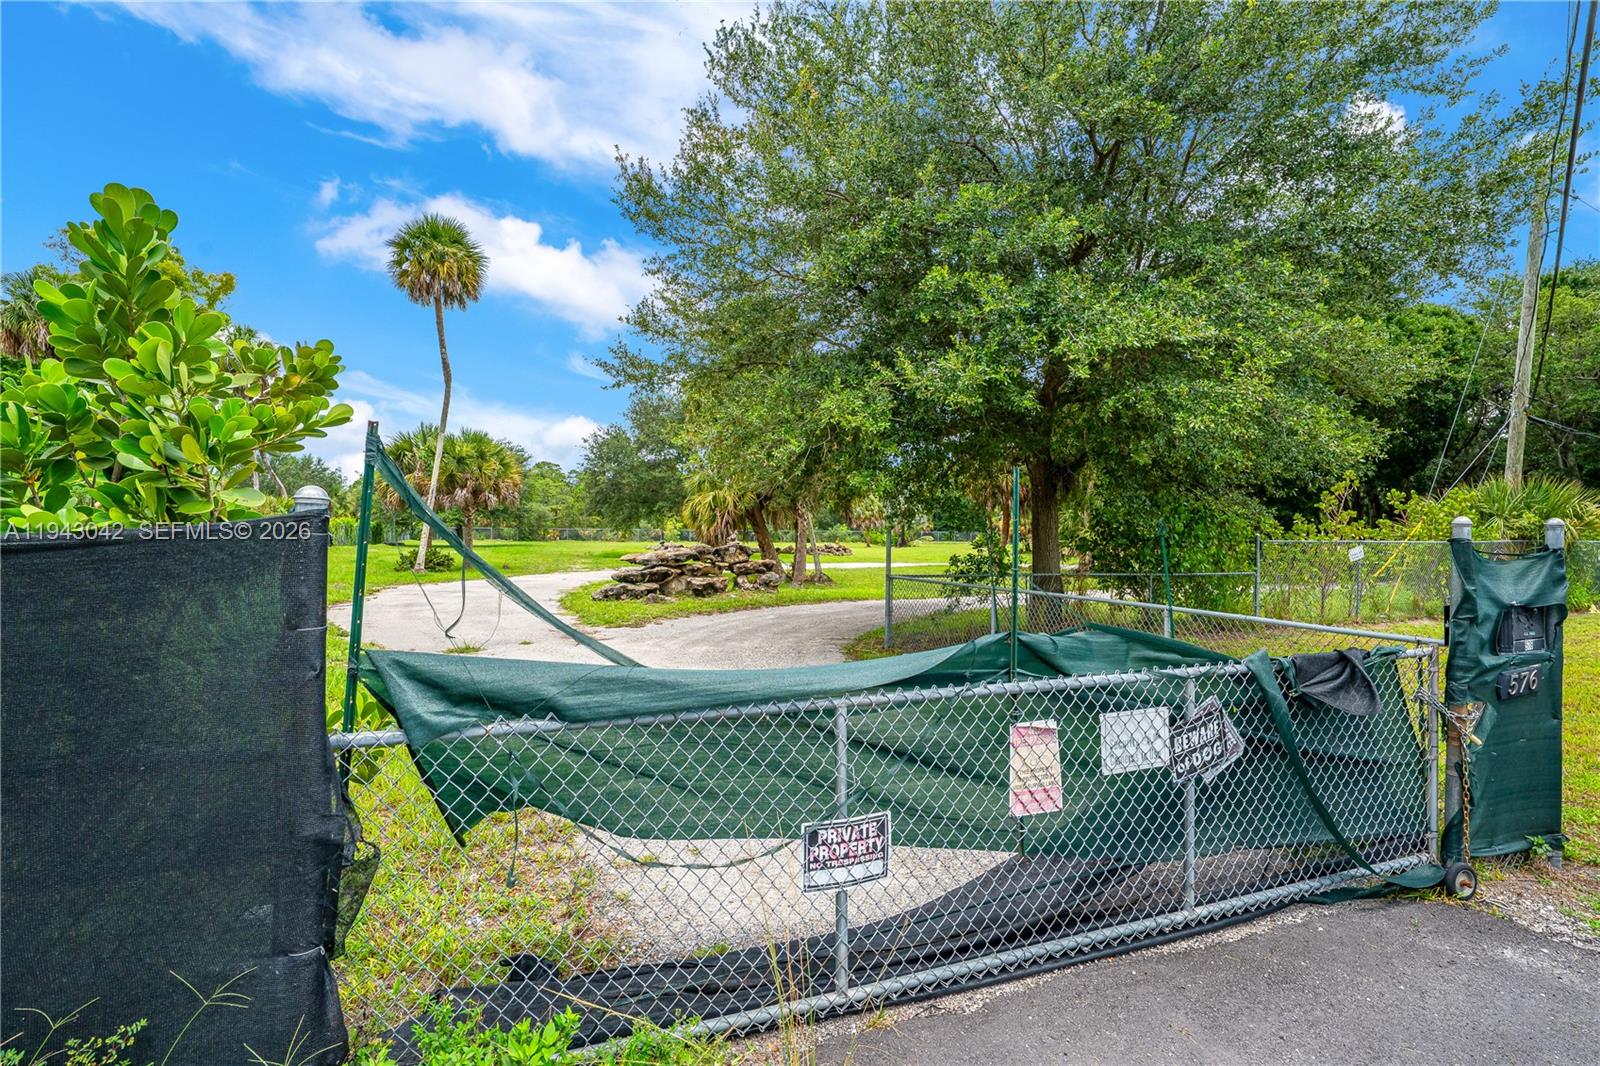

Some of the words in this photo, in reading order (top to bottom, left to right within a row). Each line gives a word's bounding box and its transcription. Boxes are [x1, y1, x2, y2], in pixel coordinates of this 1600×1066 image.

[1508, 670, 1538, 695] 576
[1174, 719, 1221, 753] BEWARE
[1192, 741, 1222, 767] DOG
[817, 821, 878, 845] PRIVATE
[809, 836, 883, 862] PROPERTY
[809, 860, 823, 870] NO
[825, 851, 884, 868] TRESPASSING
